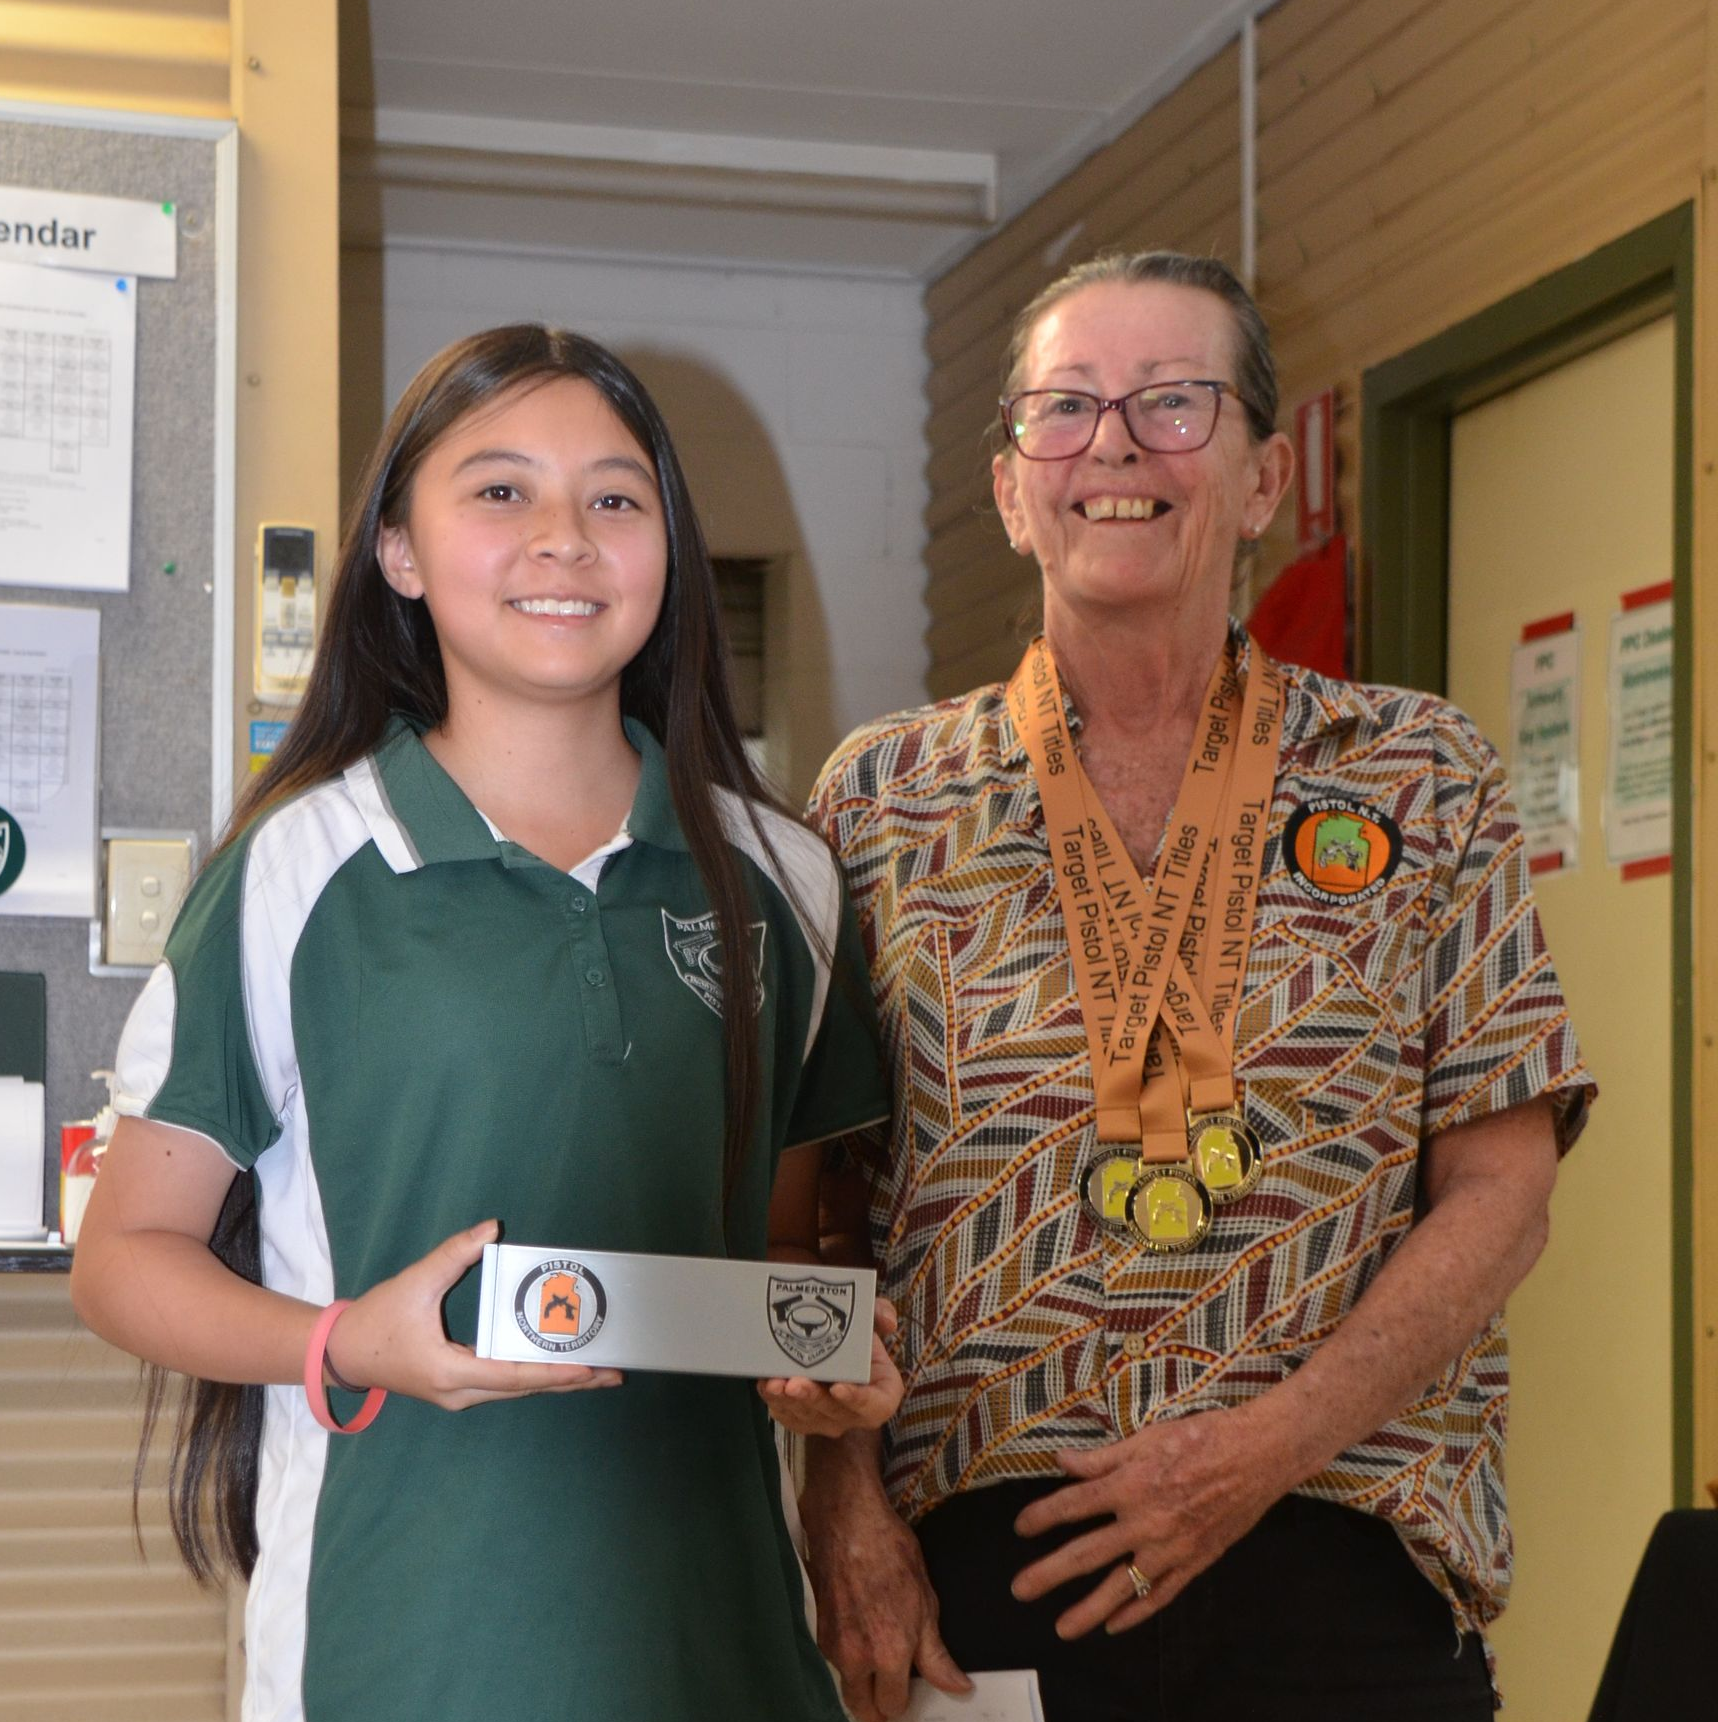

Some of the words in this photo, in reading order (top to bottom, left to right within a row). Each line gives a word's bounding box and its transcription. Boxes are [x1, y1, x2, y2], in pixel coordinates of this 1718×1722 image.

[1034, 688, 1058, 718] NT
[1252, 697, 1281, 746] Titles
[1041, 719, 1067, 777] Titles
[1193, 712, 1230, 774] Target
[1307, 799, 1356, 814] PISTOL
[1162, 824, 1199, 880] Titles
[1230, 799, 1266, 868] Target
[1062, 824, 1095, 899] Target
[1101, 879, 1137, 910] NT
[1151, 885, 1180, 921] NT
[1223, 873, 1254, 933] Pistol
[1293, 871, 1386, 906] INCORPORATED
[1076, 901, 1109, 965] Pistol
[1131, 925, 1170, 988] Pistol
[1219, 939, 1244, 971] NT
[1089, 970, 1117, 1003] NT
[1166, 979, 1201, 1037] Targe
[1109, 992, 1152, 1067] Target
[540, 1260, 585, 1276] PISTOL
[776, 1284, 848, 1297] PALMERSTON
[516, 1310, 557, 1352] NORTHERN
[558, 1314, 604, 1352] TERRITORY
